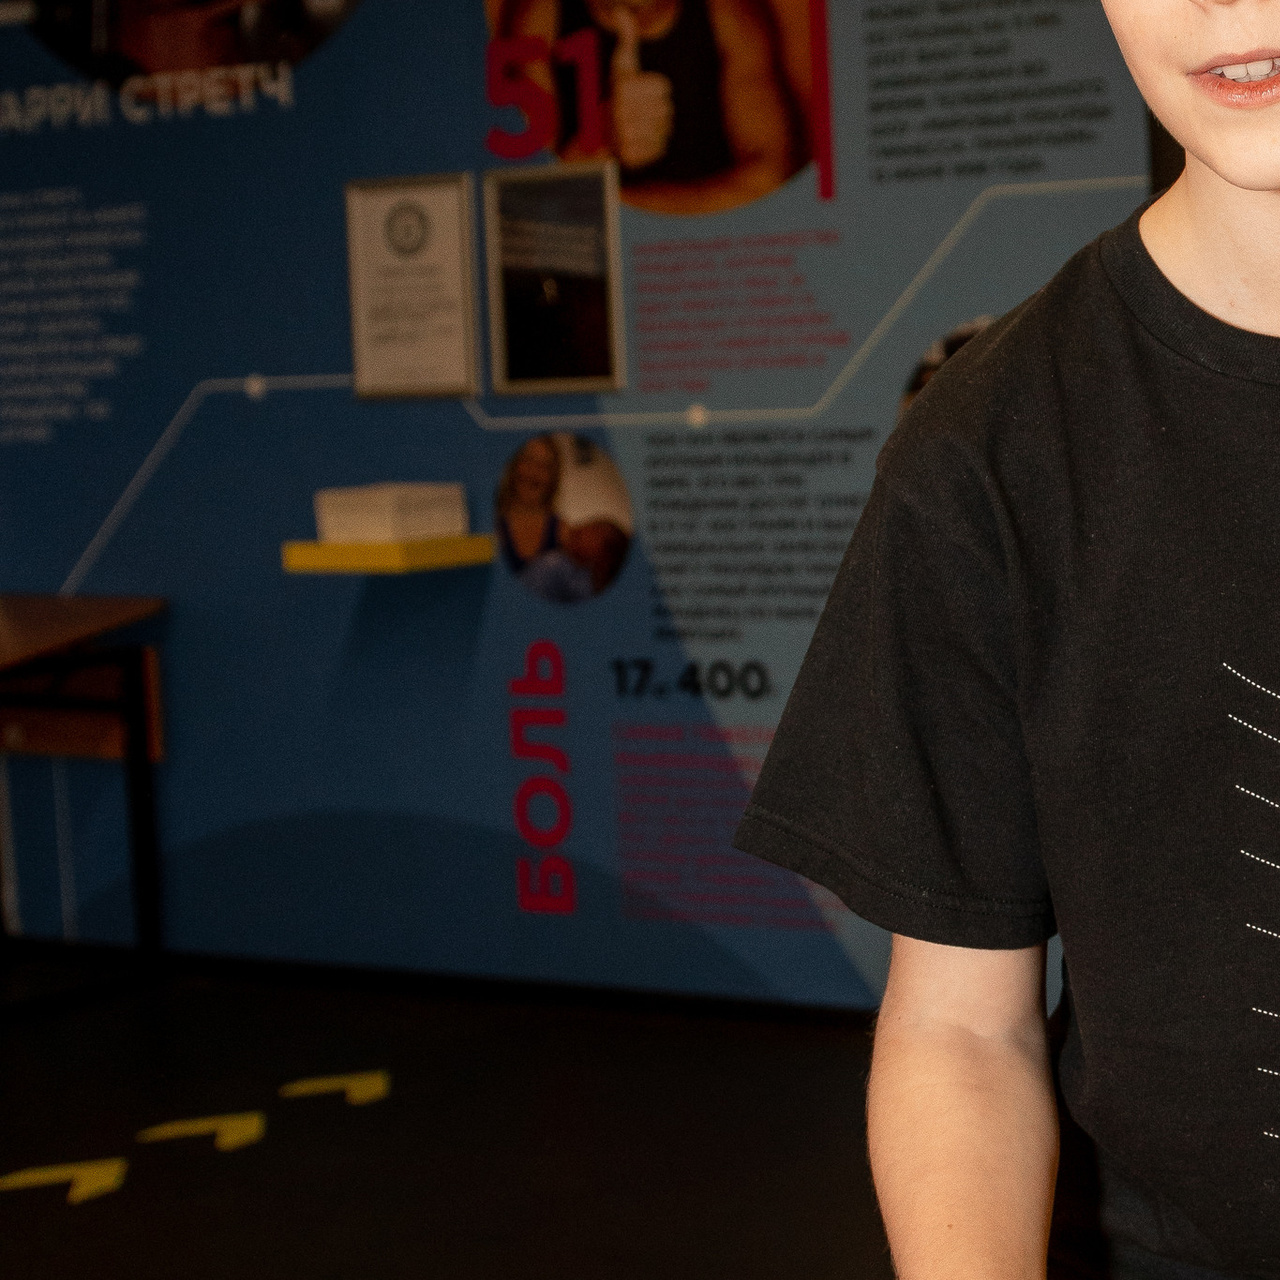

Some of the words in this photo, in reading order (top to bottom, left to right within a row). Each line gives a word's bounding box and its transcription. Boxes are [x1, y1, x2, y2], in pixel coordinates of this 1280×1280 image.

[119, 61, 295, 125] СТРЕТЧ
[487, 29, 599, 158] 51
[509, 638, 576, 914] БОЛЬ
